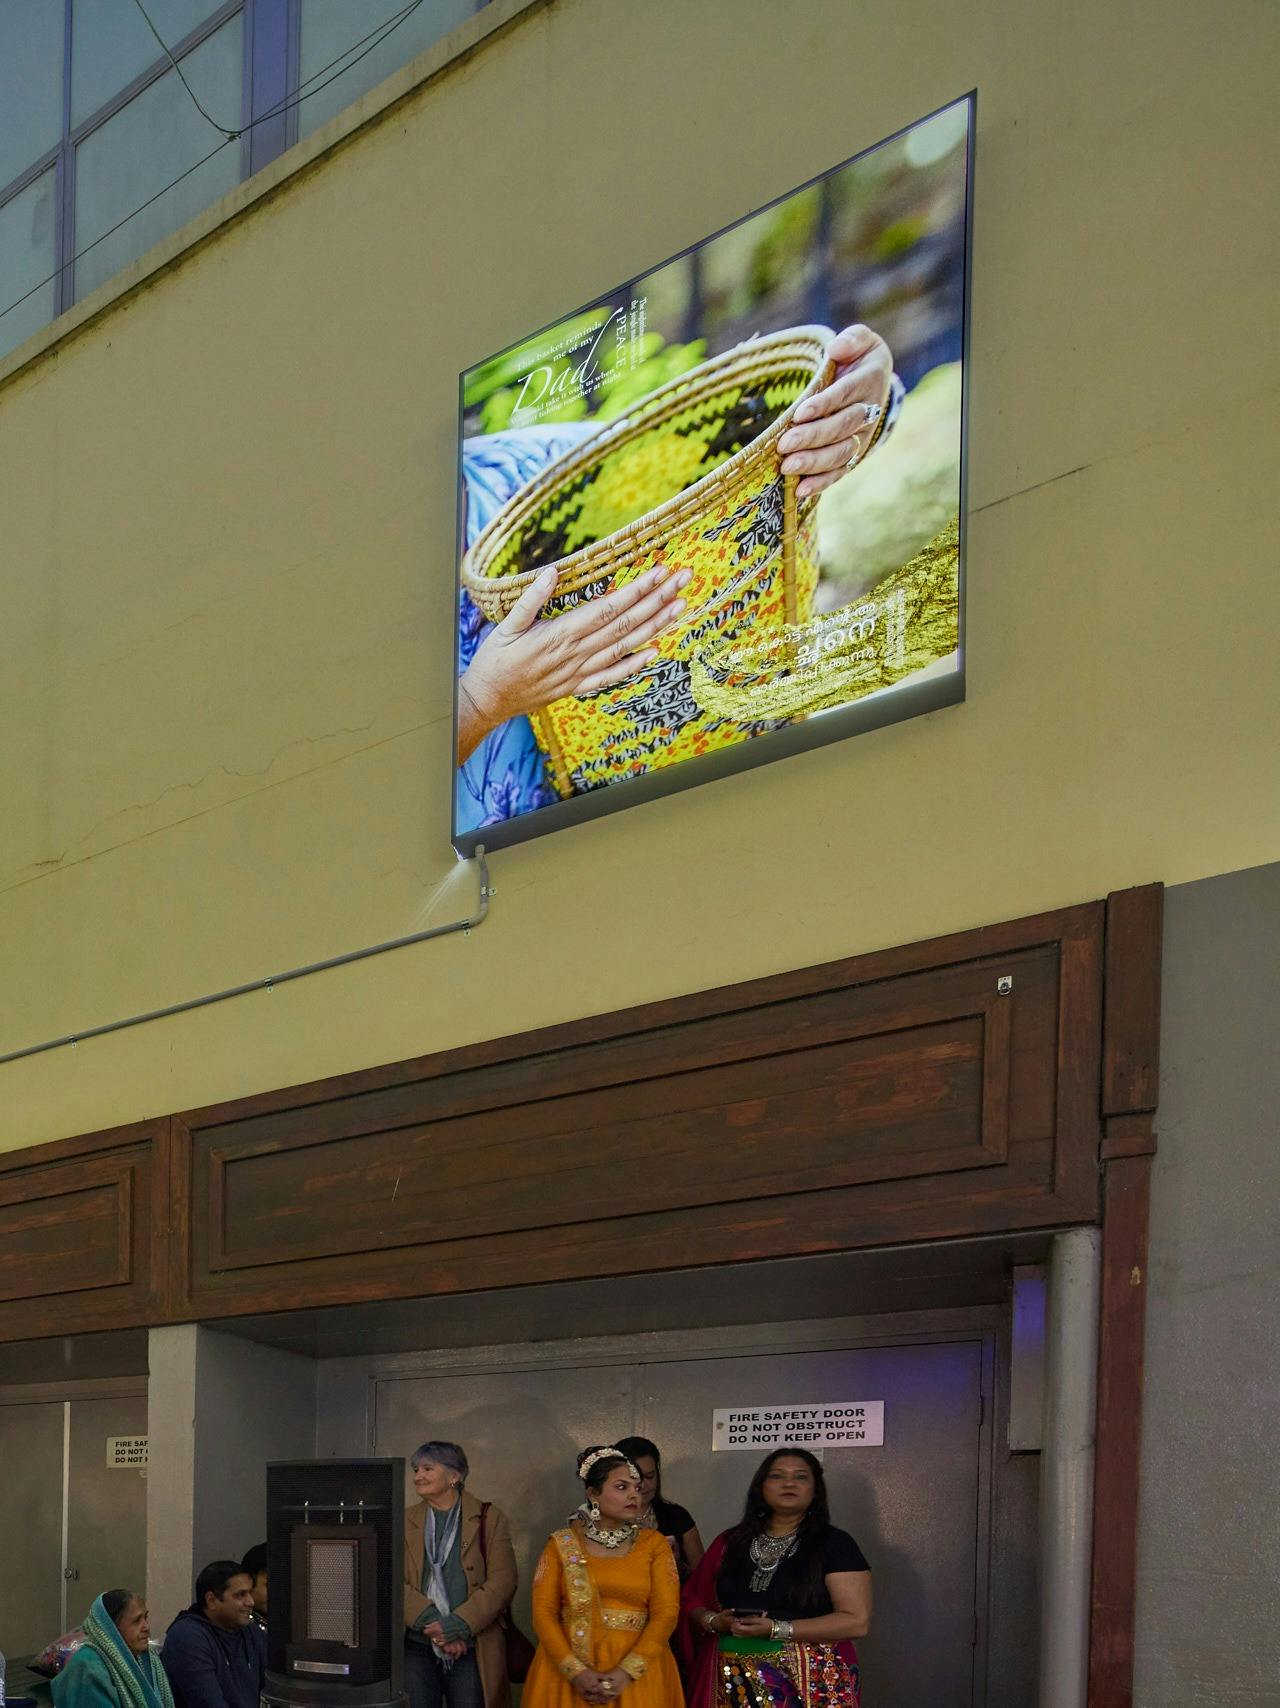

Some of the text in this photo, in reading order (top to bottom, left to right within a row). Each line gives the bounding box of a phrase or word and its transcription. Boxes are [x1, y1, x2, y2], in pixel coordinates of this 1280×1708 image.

[565, 321, 602, 345] reminds
[617, 314, 626, 369] PEACE
[511, 307, 623, 415] Dad
[552, 335, 594, 362] me of my
[568, 384, 584, 397] with
[585, 380, 595, 388] us
[595, 368, 614, 382] when
[729, 1408, 865, 1422] FIRE SAFETY DOOR
[729, 1419, 866, 1433] DO NOT OBSTRUCT
[729, 1431, 866, 1444] DO NOT KEEP OPEN
